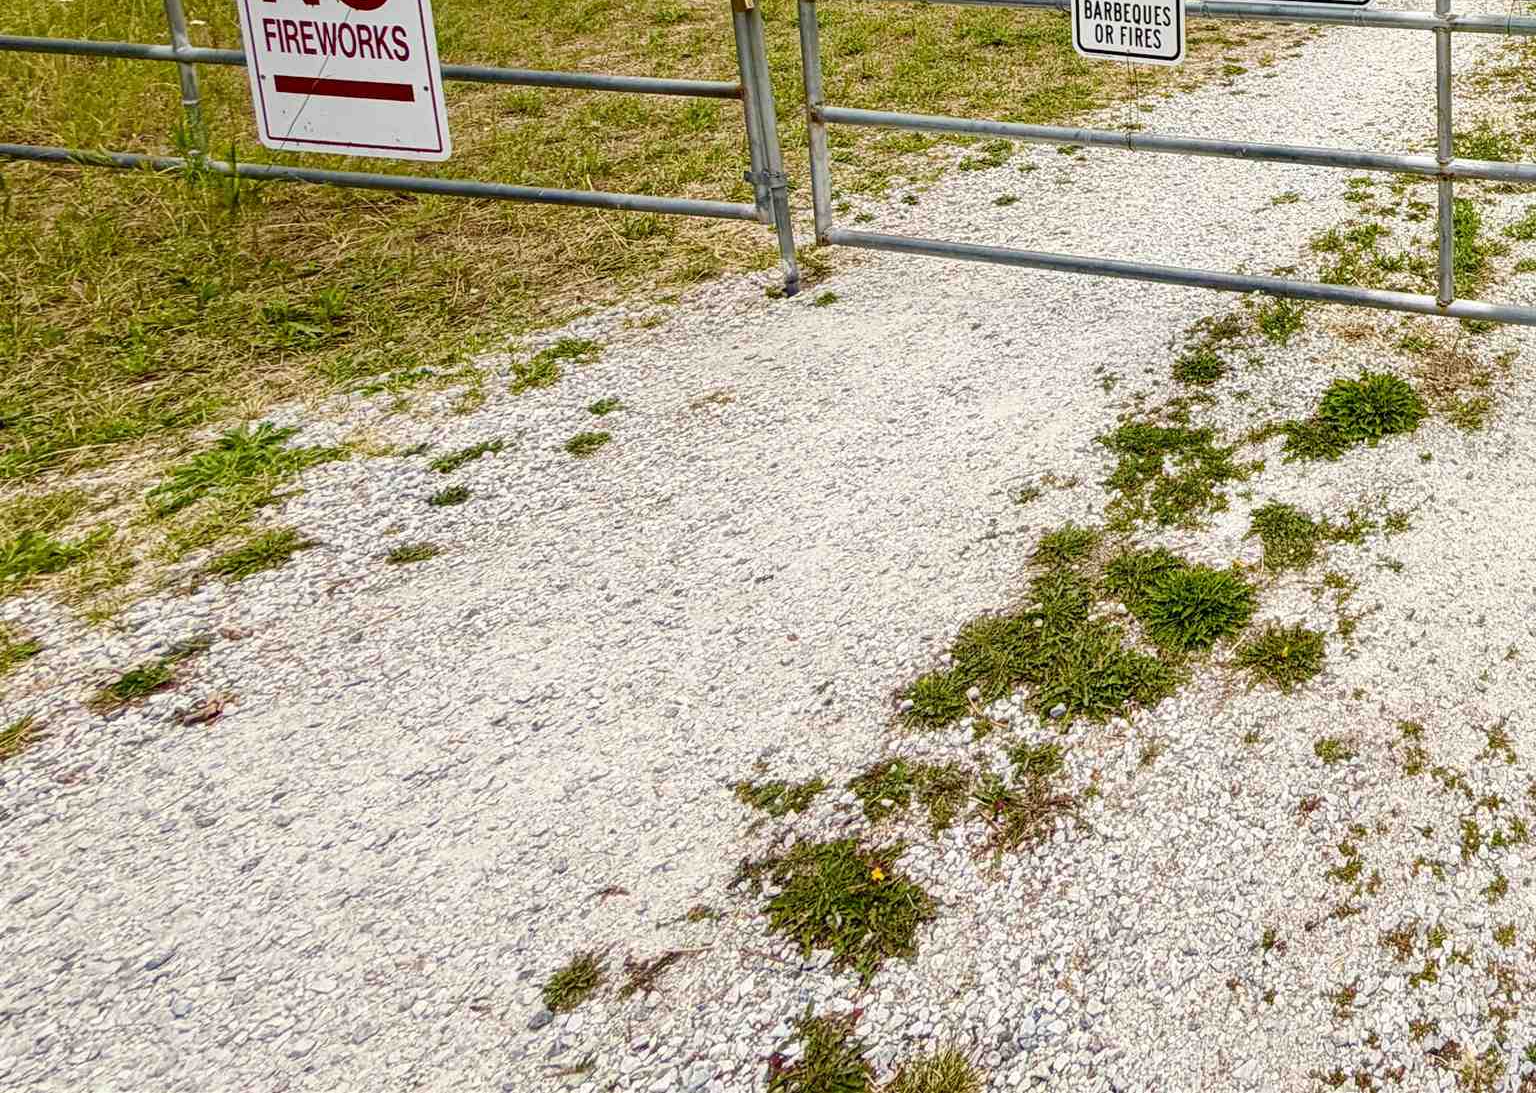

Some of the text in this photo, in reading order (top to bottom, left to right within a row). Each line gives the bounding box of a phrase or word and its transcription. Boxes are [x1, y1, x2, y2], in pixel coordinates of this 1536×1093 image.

[1084, 1, 1171, 27] BARBEQUES
[262, 18, 410, 62] FIREWORKS
[1095, 23, 1162, 49] OR FIRES
